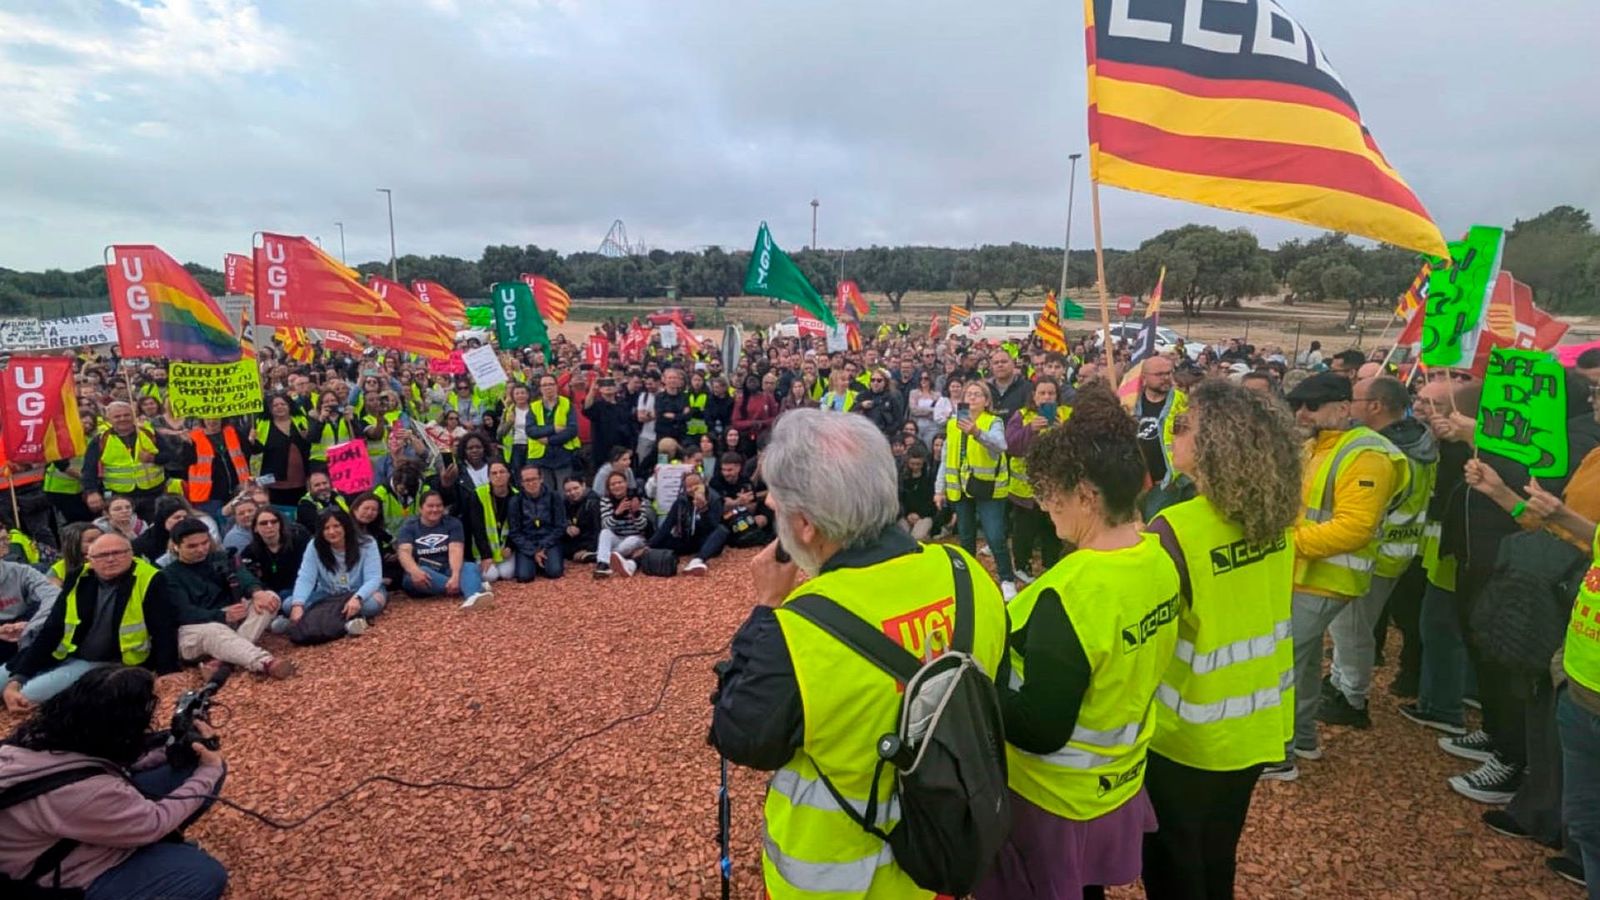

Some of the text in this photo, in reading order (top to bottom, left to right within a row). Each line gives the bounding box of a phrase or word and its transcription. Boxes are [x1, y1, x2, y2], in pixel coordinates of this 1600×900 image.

[1108, 0, 1347, 88] CCO
[228, 256, 237, 286] UGT
[265, 242, 288, 311] UGT
[757, 229, 771, 285] UGT
[121, 256, 153, 337] UGT
[265, 311, 289, 320] .cat
[416, 282, 431, 304] UG
[501, 287, 517, 337] UGT
[136, 338, 160, 350] .cat
[15, 366, 46, 442] UGT
[417, 545, 448, 555] umbro
